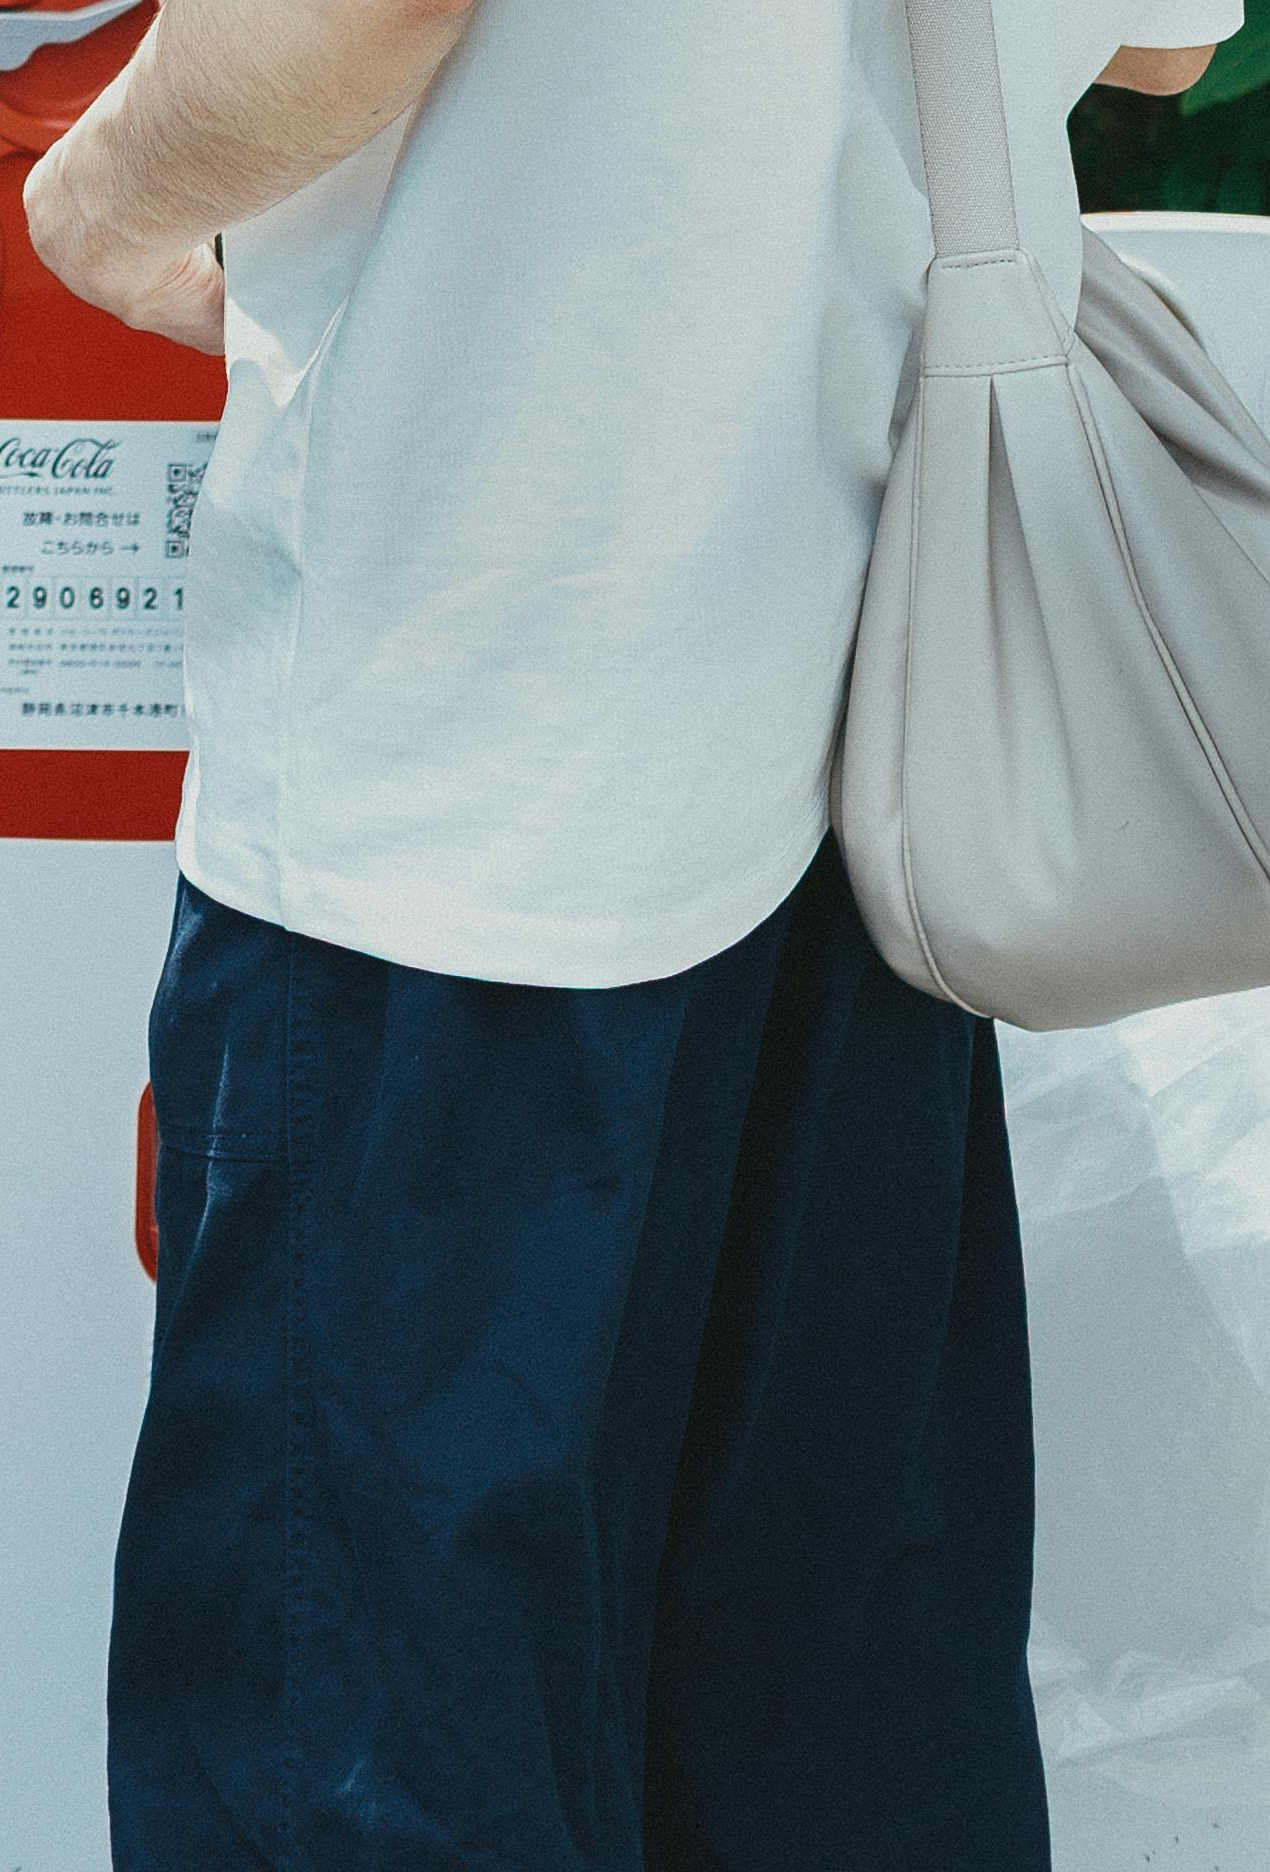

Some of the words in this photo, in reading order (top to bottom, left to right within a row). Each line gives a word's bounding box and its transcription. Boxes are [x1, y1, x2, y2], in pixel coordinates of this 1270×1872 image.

[41, 540, 114, 556] こちらから
